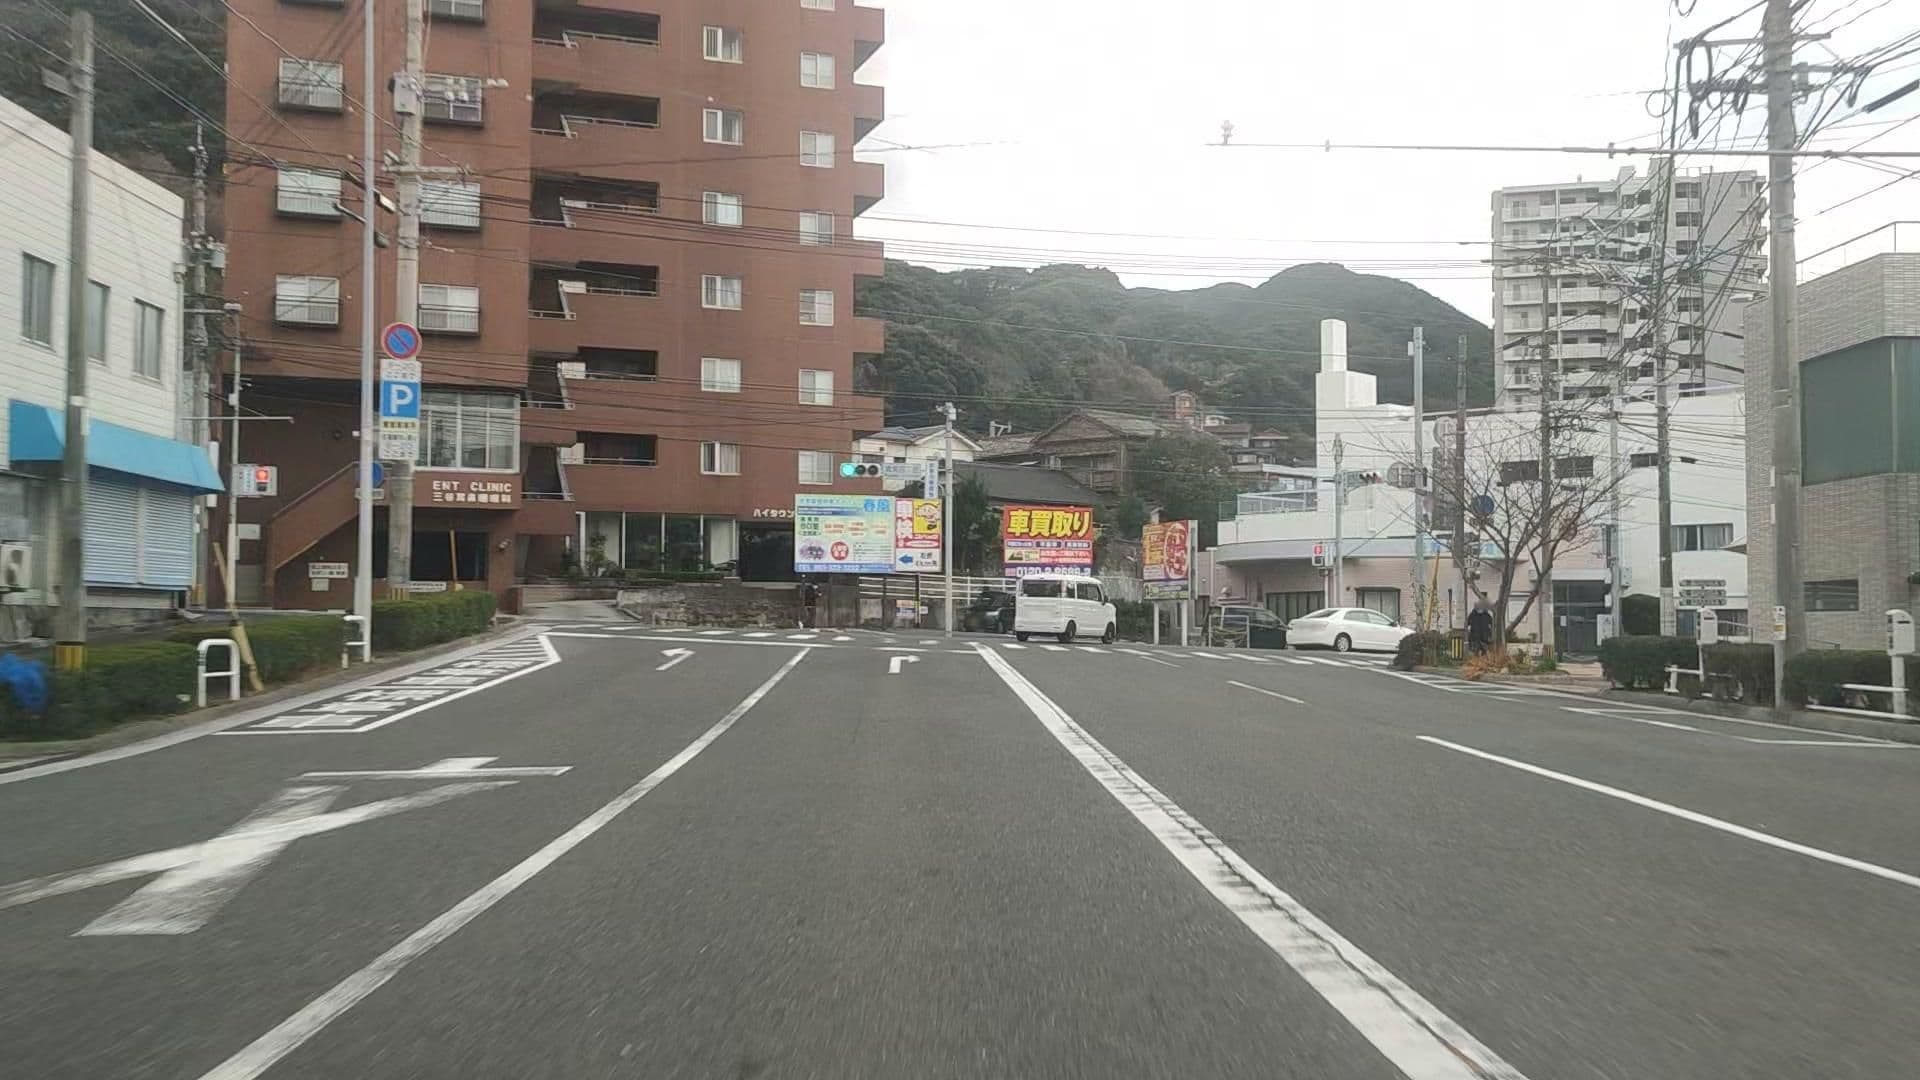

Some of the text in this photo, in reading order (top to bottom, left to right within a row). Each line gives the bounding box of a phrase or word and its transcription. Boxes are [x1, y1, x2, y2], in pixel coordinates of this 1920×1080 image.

[390, 384, 413, 414] P
[432, 480, 512, 493] ENT CLINIC
[1007, 508, 1090, 538] 車買取り
